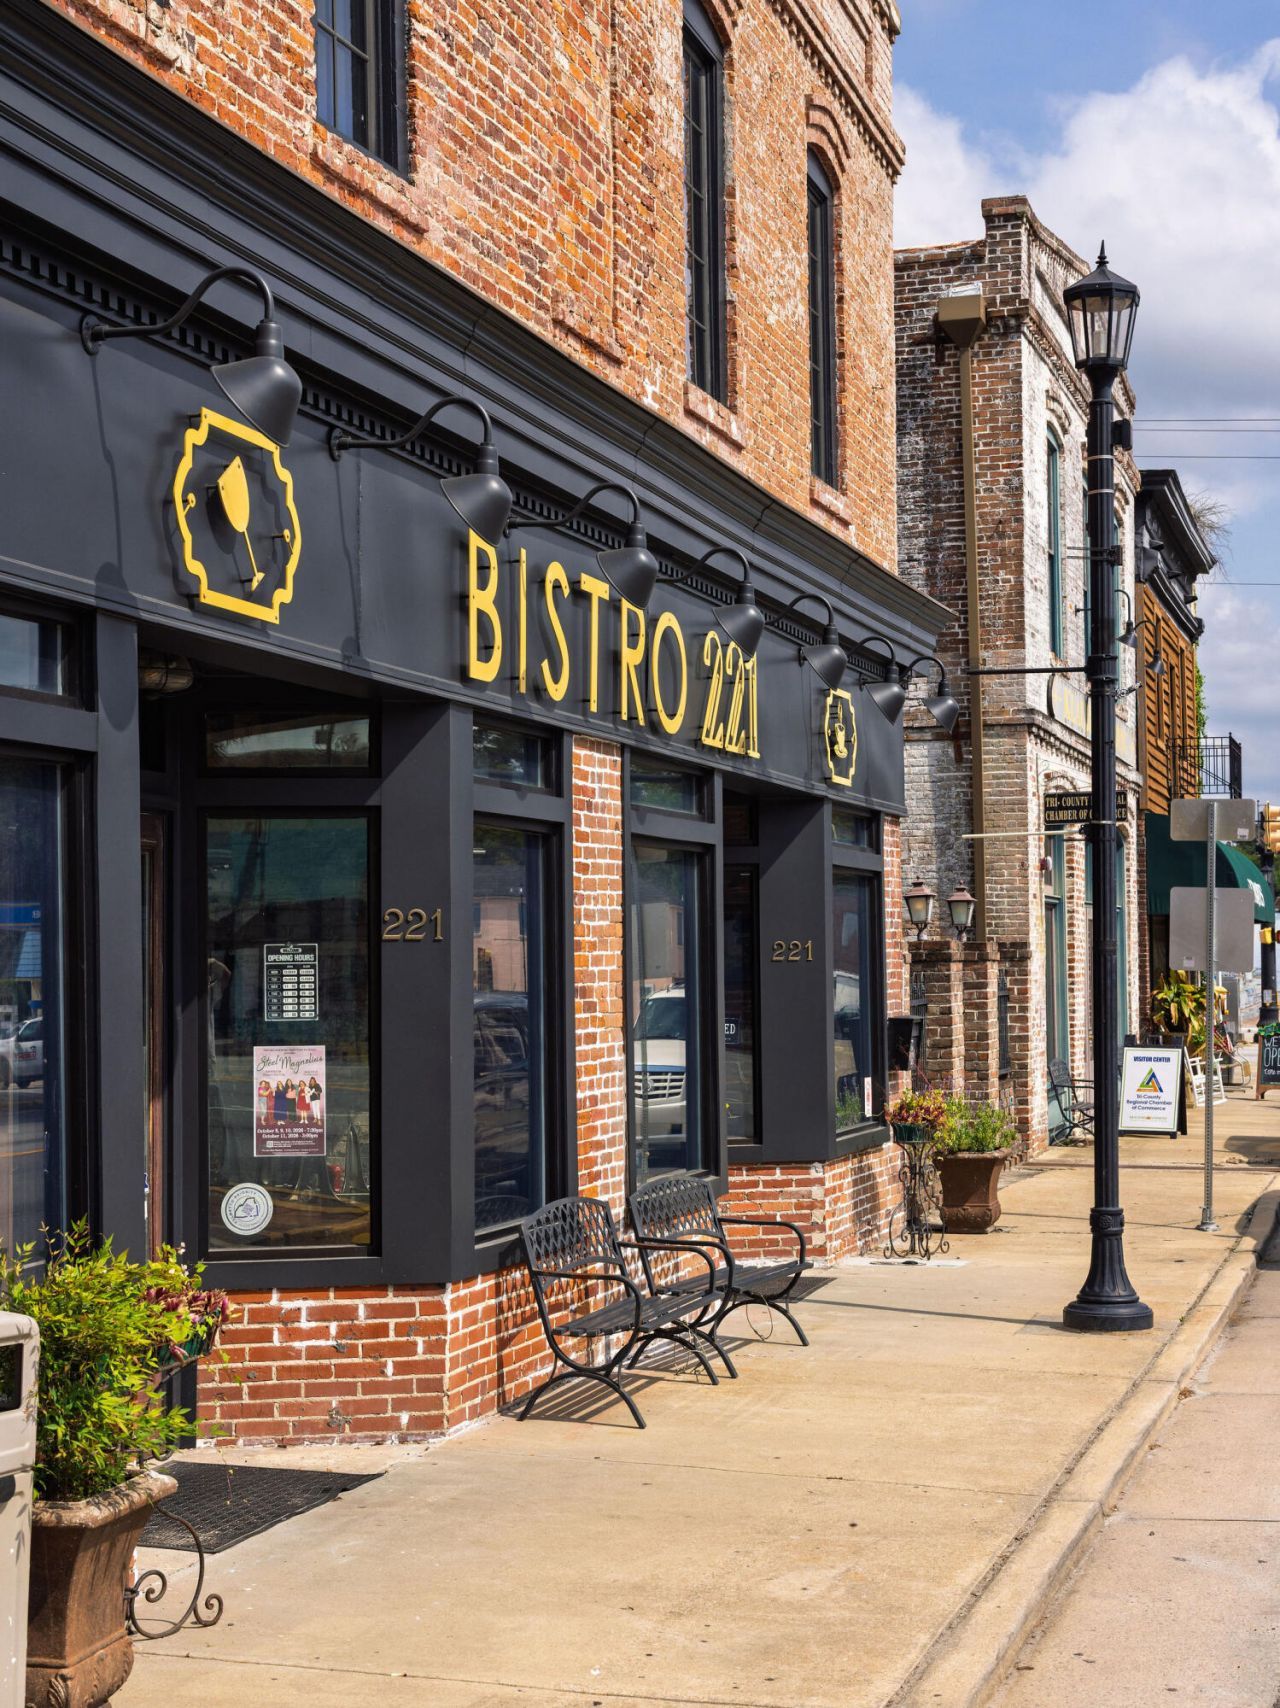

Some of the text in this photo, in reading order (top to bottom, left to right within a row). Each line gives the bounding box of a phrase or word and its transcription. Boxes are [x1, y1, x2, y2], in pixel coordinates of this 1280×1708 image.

[468, 528, 760, 759] BISTRO 221
[1062, 796, 1089, 807] COUNTY
[1045, 810, 1077, 821] CHAMBER
[1079, 809, 1087, 820] OF
[382, 908, 444, 940] 221
[772, 940, 813, 961] 221
[256, 1055, 279, 1072] Steel
